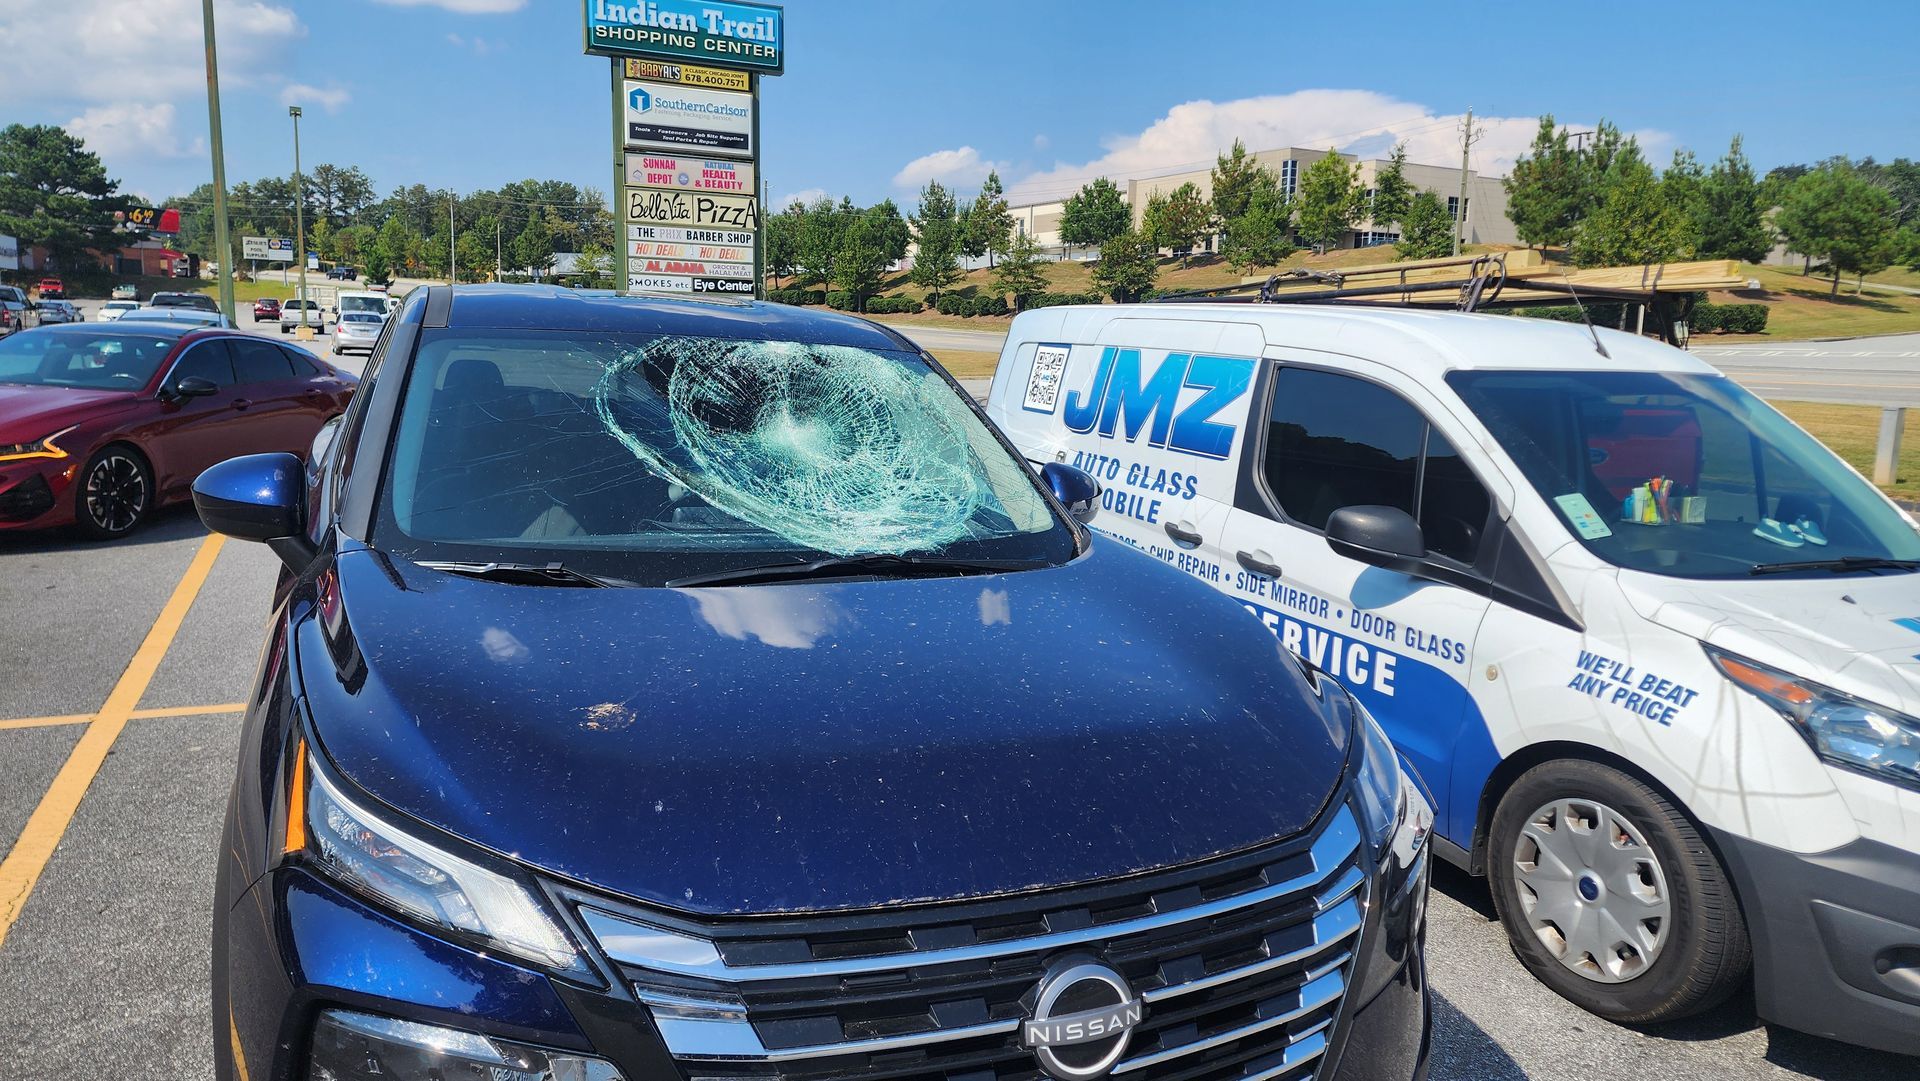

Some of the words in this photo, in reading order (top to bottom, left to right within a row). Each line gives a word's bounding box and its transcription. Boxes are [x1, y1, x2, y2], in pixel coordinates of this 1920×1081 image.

[594, 0, 698, 32] Indian
[703, 8, 776, 42] Trail
[595, 24, 696, 48] SHOPPING
[704, 38, 775, 58] CENTER
[685, 73, 745, 88] 678.400.7571
[708, 70, 730, 78] CHICAGO
[655, 97, 747, 117] SouthernCarlson
[657, 128, 688, 136] Fasteners
[643, 157, 676, 170] SUNNAH
[704, 160, 735, 170] NATURAL
[647, 172, 673, 185] DEPOT
[702, 169, 736, 180] HEALTH
[694, 179, 702, 188] &
[704, 179, 743, 190] BEAUTY
[636, 227, 655, 238] THE
[686, 230, 724, 243] BARBER
[727, 232, 752, 244] SHOP
[635, 242, 653, 255] HOT
[699, 246, 717, 259] HOT
[628, 278, 672, 288] SMOKES
[694, 278, 715, 292] Eye
[717, 279, 754, 292] Center
[1063, 346, 1257, 461] JMZ
[1072, 450, 1121, 481] AUTO
[1126, 462, 1198, 501] GLASS
[1102, 487, 1162, 525] OBILE
[1177, 552, 1220, 582] REPAIR
[1236, 571, 1266, 597] SIDE
[1270, 580, 1329, 619] MIRROR
[1350, 608, 1396, 642] DOOR
[1405, 626, 1466, 665] GLASS
[1576, 649, 1635, 686] WE'LL
[1637, 673, 1700, 709] BEAT
[1567, 672, 1613, 699] ANY
[1611, 687, 1680, 728] PRICE
[1030, 1005, 1141, 1043] NISSAN
